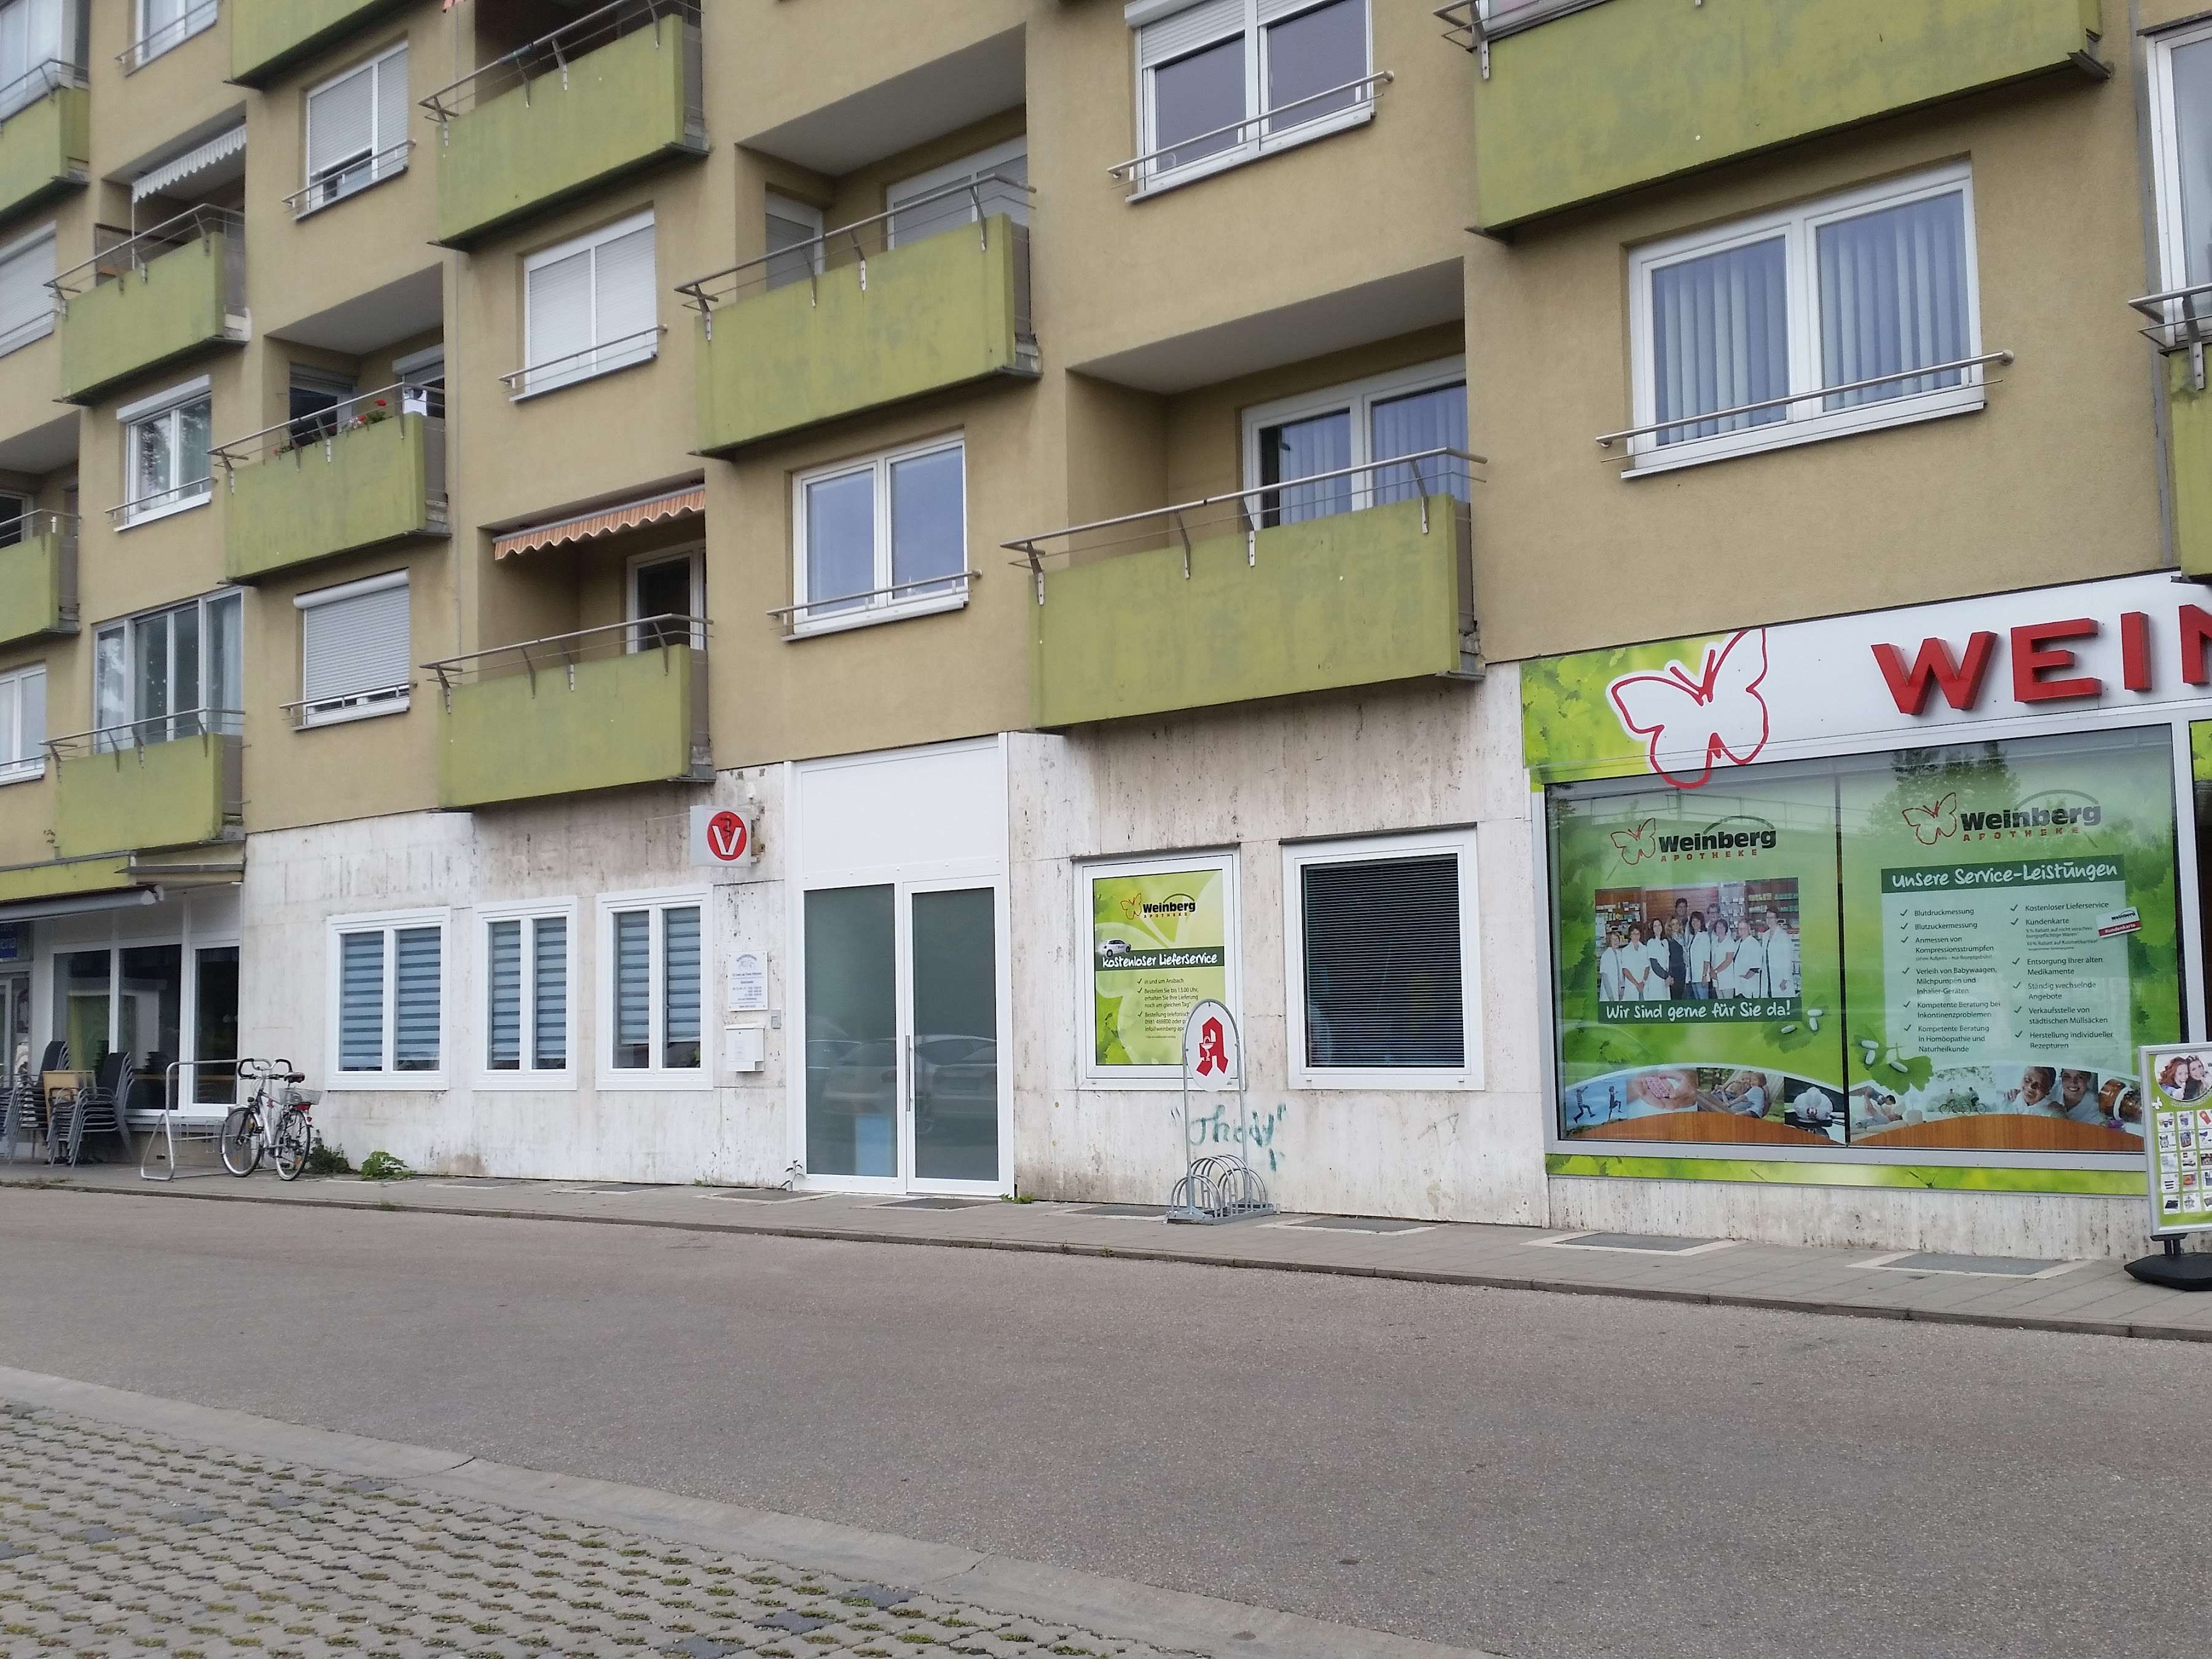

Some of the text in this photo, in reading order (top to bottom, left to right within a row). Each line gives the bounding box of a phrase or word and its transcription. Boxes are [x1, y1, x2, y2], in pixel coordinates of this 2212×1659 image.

[1961, 804, 2101, 832] Weinberg
[1659, 829, 1776, 853] Weinberg
[1963, 827, 2079, 842] APOTHEKE
[1661, 849, 1758, 862] APOTHEKE
[1143, 901, 1196, 914] Weinberg
[2104, 923, 2136, 933] Kundenkarte
[1159, 952, 1218, 966] Lieferservice
[1953, 967, 1997, 975] Babywaagen,
[1606, 1005, 1631, 1020] Wir
[1668, 1005, 1707, 1022] gerne
[1711, 1002, 1736, 1018] für
[1739, 1002, 1761, 1017] Sie
[1767, 1000, 1791, 1016] da!
[1958, 1000, 1988, 1009] Beratung
[1918, 1011, 1991, 1019] Inkontinenzproblemen
[1959, 1024, 1990, 1033] Beratung
